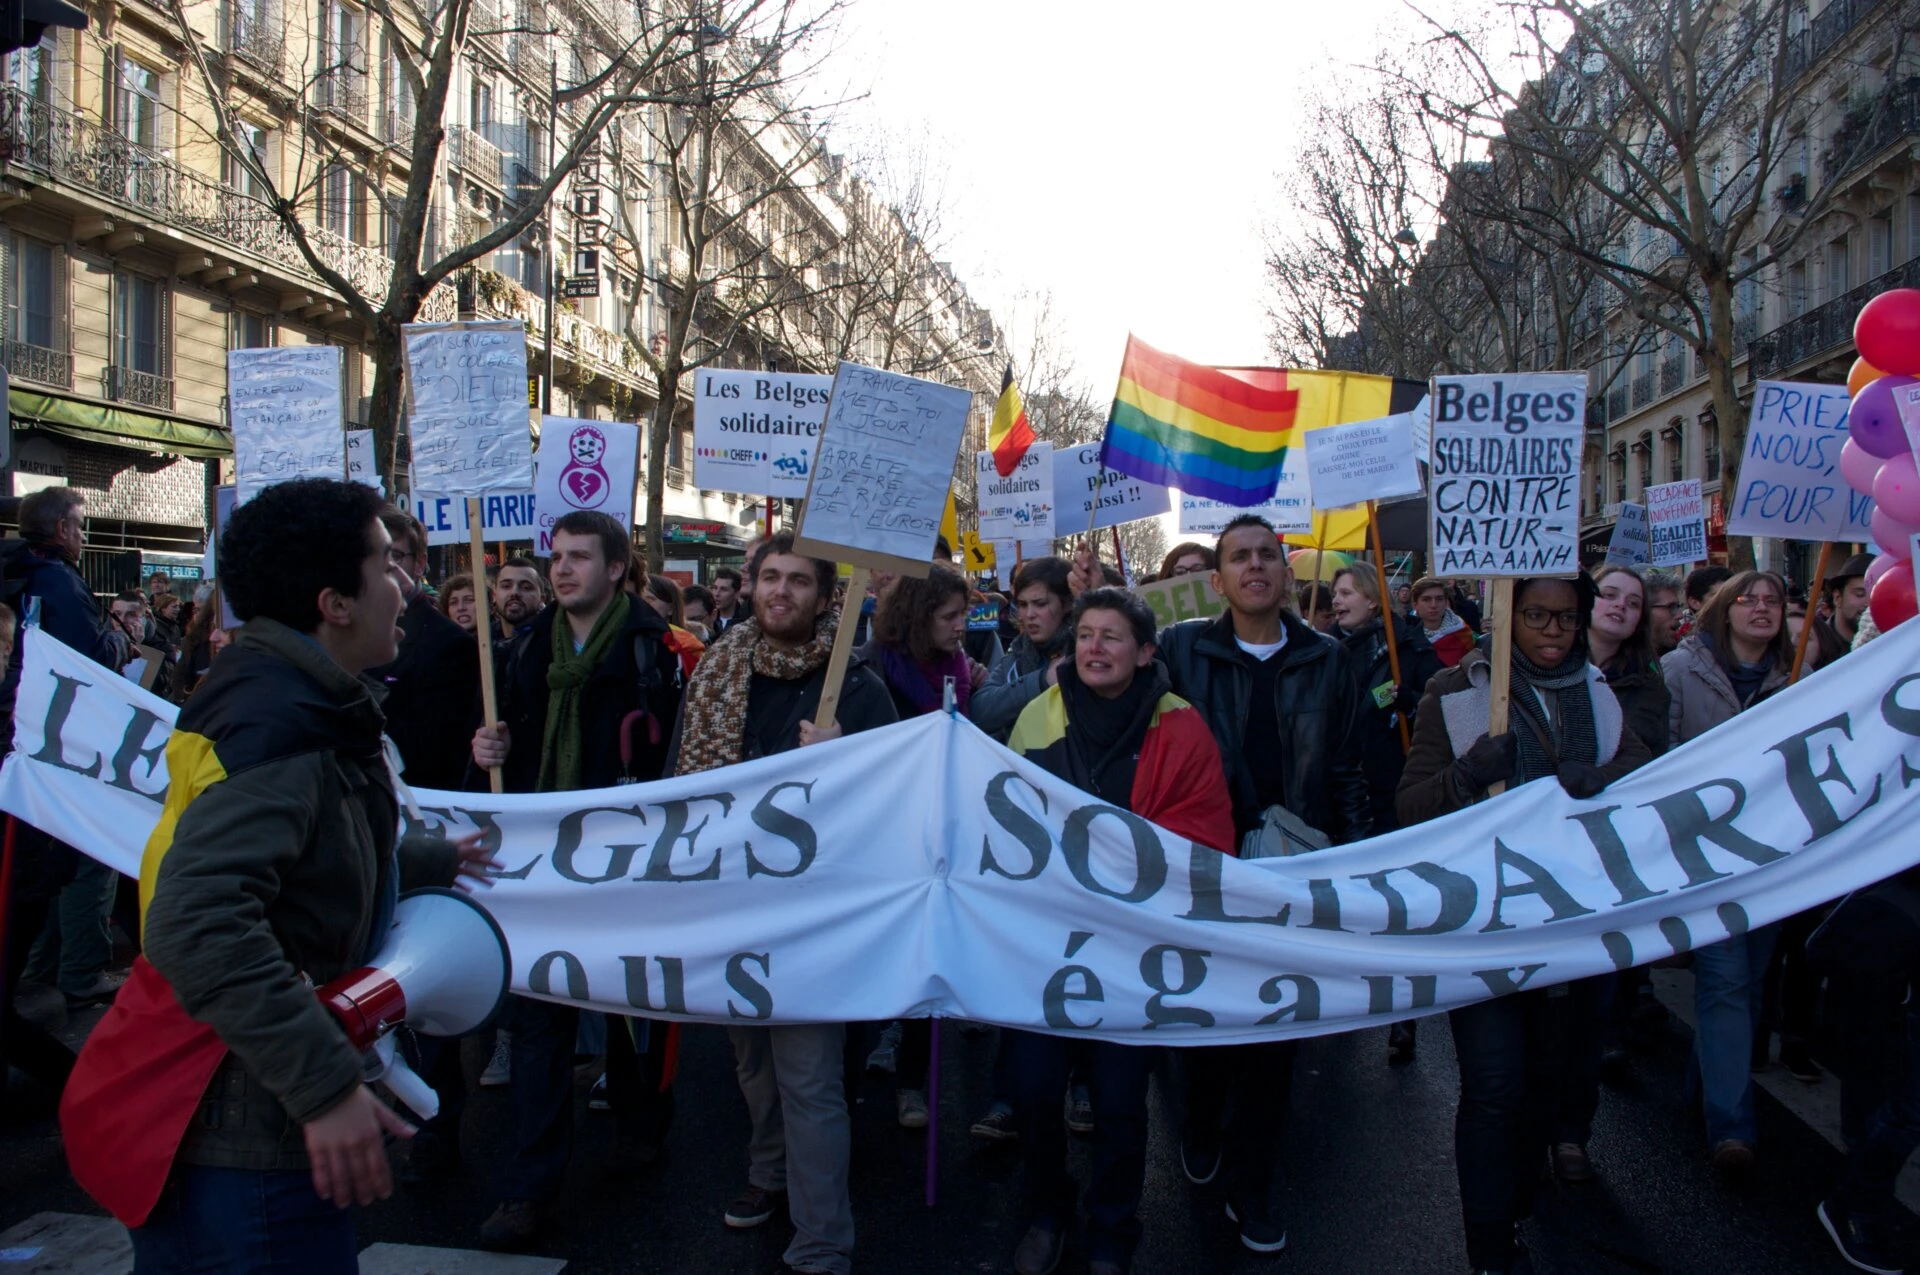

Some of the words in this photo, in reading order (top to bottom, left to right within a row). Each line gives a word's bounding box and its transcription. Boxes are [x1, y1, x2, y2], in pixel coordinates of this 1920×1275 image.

[580, 286, 597, 294] SUEZ
[306, 352, 329, 361] EST
[435, 356, 448, 369] LA
[236, 386, 280, 398] ENTRE
[288, 383, 305, 394] UN
[705, 376, 740, 399] Les
[755, 379, 829, 409] Belges
[847, 369, 923, 402] FRANCE,
[840, 390, 941, 420] METS-TOI
[1436, 381, 1576, 434] Belges
[454, 412, 499, 429] SUIS
[849, 413, 910, 435] JOUR
[917, 424, 925, 440] !
[119, 436, 165, 449] MARYLINE
[478, 433, 510, 450] ET
[1318, 437, 1326, 446] JE
[1344, 431, 1358, 440] PAS
[1360, 429, 1370, 437] EU
[1337, 441, 1360, 451] CHOIX
[730, 448, 753, 461] CHEFF
[1331, 451, 1360, 462] GOUINE
[1435, 437, 1573, 475] SOLIDAIRES
[1751, 431, 1836, 476] NOUS,
[20, 459, 63, 475] MARYLINE
[980, 456, 997, 472] Le
[1318, 459, 1364, 474] LAISSEZ-MOI
[1365, 455, 1386, 466] CELUI
[1342, 471, 1352, 480] DE
[1354, 468, 1365, 478] ME
[1367, 463, 1395, 475] MARIER
[816, 483, 843, 498] LA
[988, 477, 1040, 496] solidaires
[1436, 475, 1576, 515] CONTRE
[813, 498, 848, 513] DE
[1083, 490, 1125, 511] aussi
[1129, 486, 1141, 502] !!
[1183, 501, 1196, 510] ÇA
[1199, 500, 1212, 509] NE
[1275, 498, 1300, 507] RIEN
[1741, 480, 1834, 525] POUR
[417, 498, 451, 531] LE
[1622, 505, 1636, 519] Les
[1436, 516, 1564, 549] NATUR-
[1652, 519, 1702, 543] ÉGALITÉ
[1652, 541, 1669, 558] DES
[1670, 537, 1703, 555] DROITS
[1442, 544, 1572, 572] AAAAANH
[172, 566, 198, 577] SOLDES
[968, 607, 998, 621] OUI
[979, 672, 1920, 936] SOLIDAIRES
[529, 950, 774, 1020] ous
